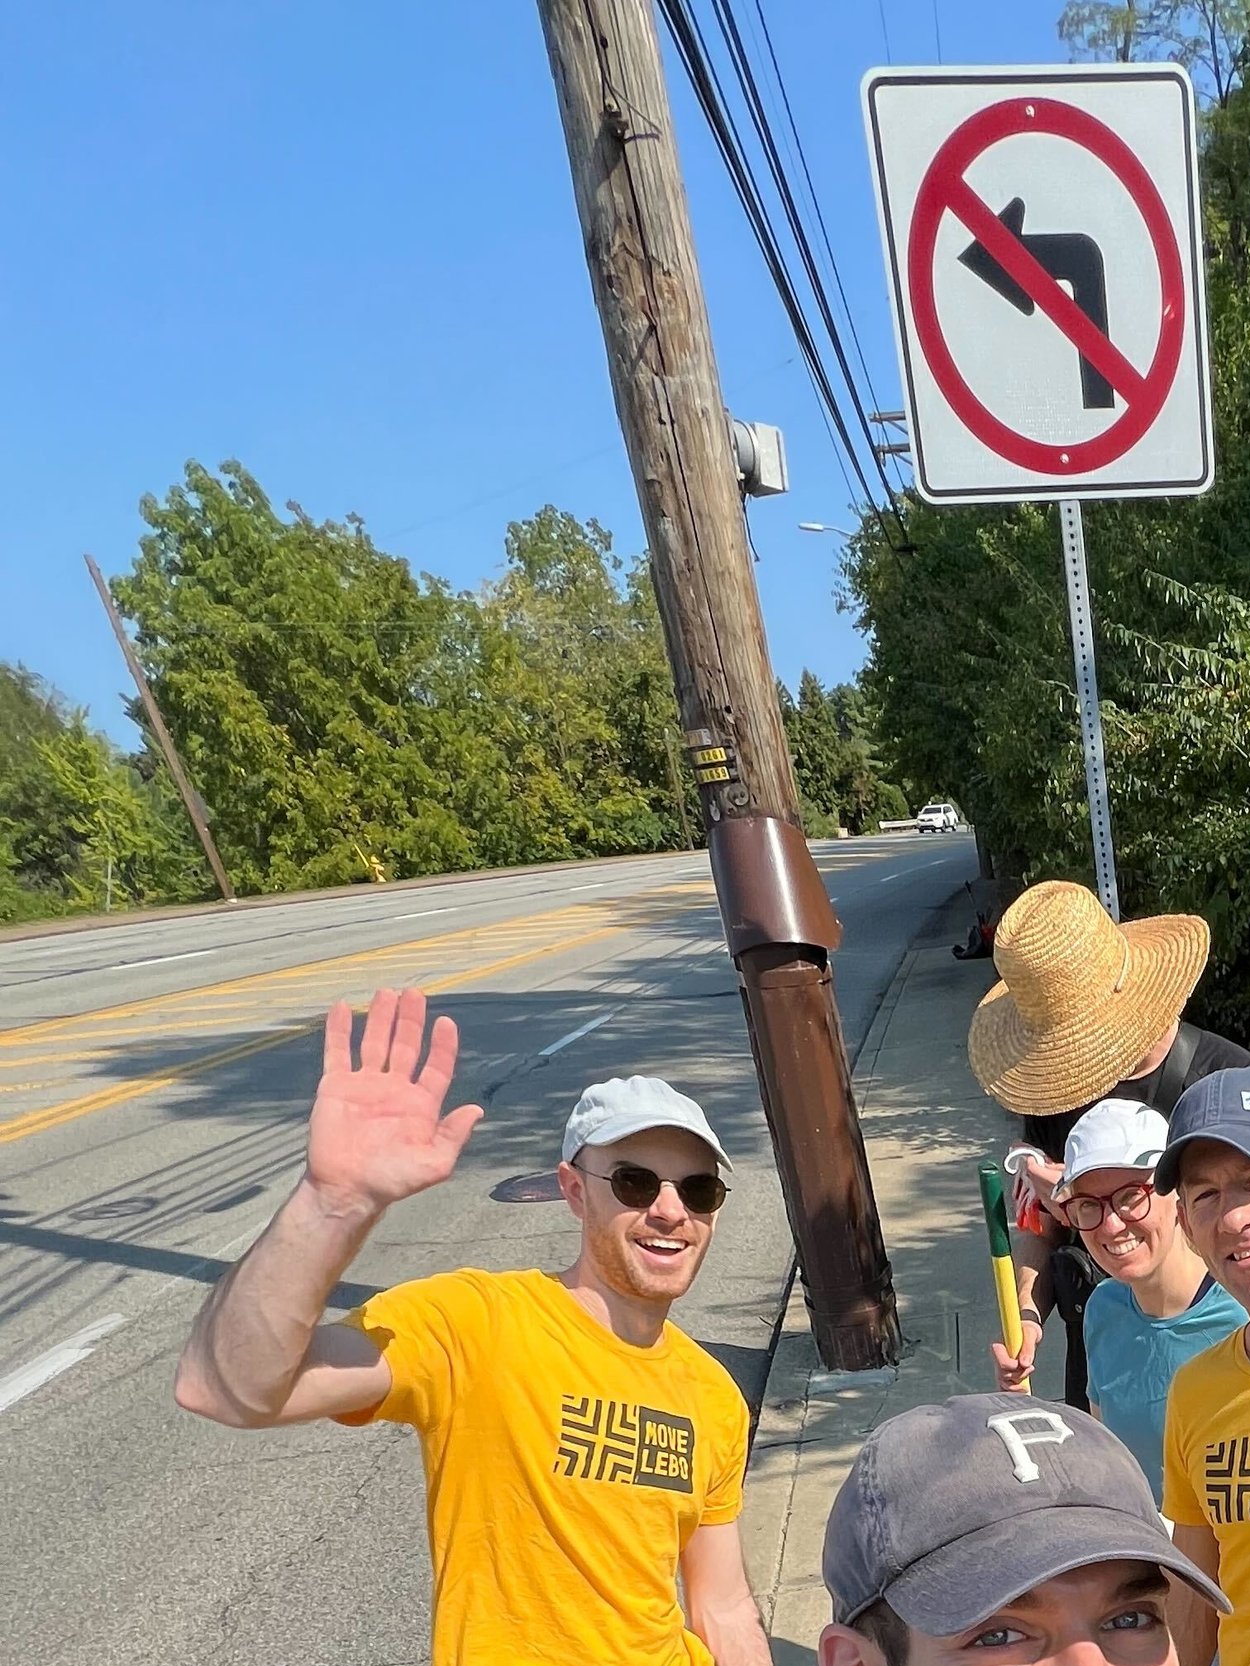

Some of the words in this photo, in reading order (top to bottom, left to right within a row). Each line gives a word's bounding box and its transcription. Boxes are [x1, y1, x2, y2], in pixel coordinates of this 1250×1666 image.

[644, 1420, 689, 1454] MOVE
[986, 1407, 1075, 1483] P
[640, 1448, 689, 1481] LEBO
